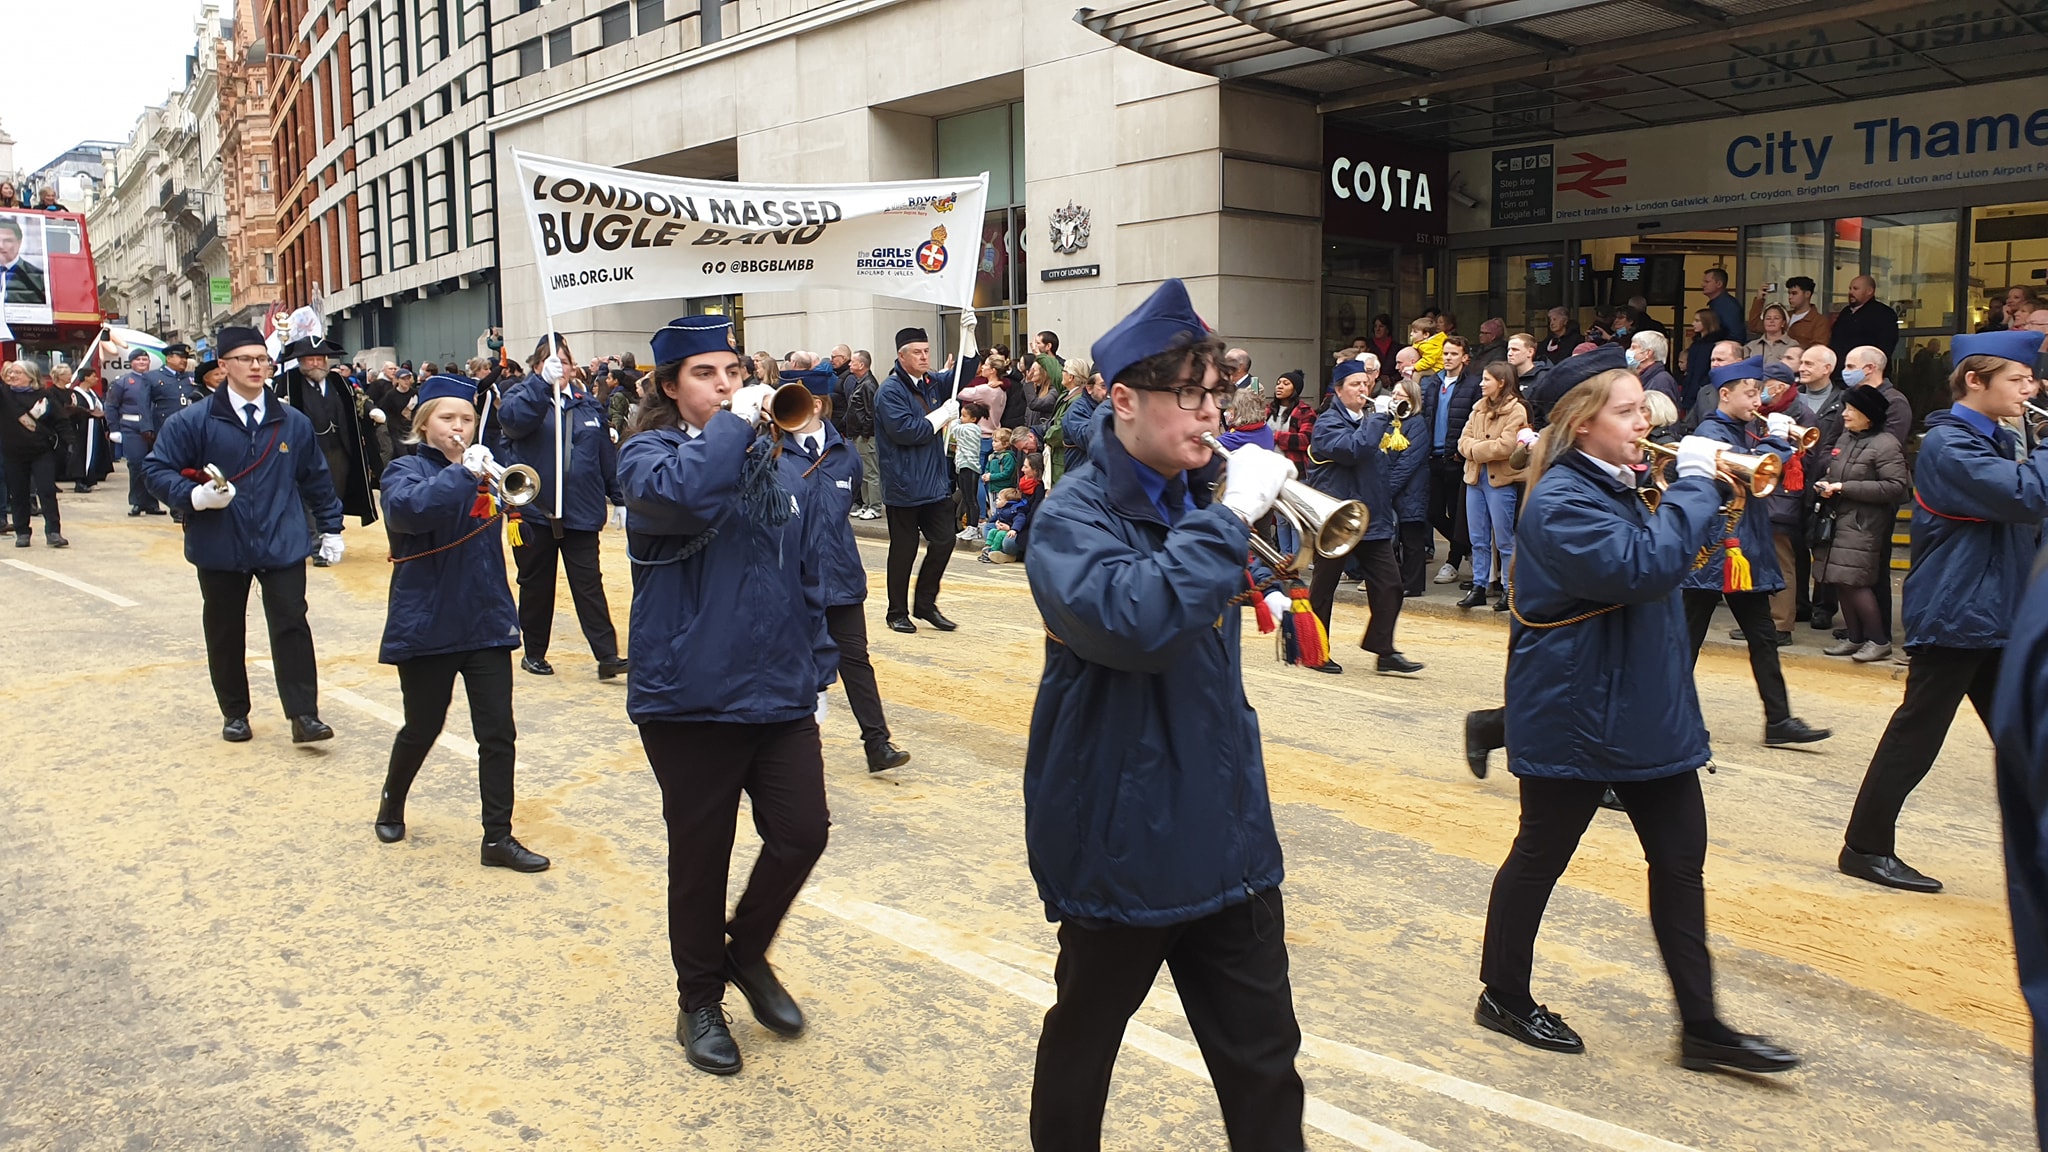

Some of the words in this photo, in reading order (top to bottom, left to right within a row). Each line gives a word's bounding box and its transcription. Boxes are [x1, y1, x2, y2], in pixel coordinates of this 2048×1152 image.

[1727, 130, 1833, 181] City
[1854, 107, 2048, 165] Thame
[1331, 156, 1432, 212] COSTA
[1500, 179, 1518, 188] Step
[1556, 209, 1581, 219] Direct
[1584, 206, 1608, 216] trains
[1611, 205, 1621, 213] to
[1635, 199, 1669, 211] London
[1671, 195, 1709, 208] Gatwick
[1797, 183, 1840, 196] Brighton
[1897, 175, 1928, 186] Luton
[1931, 172, 1953, 182] and
[1956, 168, 1989, 180] Luton
[1992, 163, 2033, 176] Airport
[533, 175, 699, 222] LONDON
[708, 198, 842, 226] MASSED
[1500, 188, 1534, 199] entrance
[1498, 209, 1531, 221] Ludgate
[1533, 207, 1546, 217] Hill
[538, 211, 687, 256] BUGLE
[691, 224, 827, 246] BAND
[858, 250, 870, 258] the
[872, 247, 914, 259] GIRLS'
[730, 258, 814, 274] @BBGBLMBB
[857, 258, 914, 268] BRIGADE
[549, 266, 634, 290] LMBB.ORG.UK
[1048, 270, 1060, 278] CITY
[1060, 269, 1067, 277] OF
[1067, 267, 1090, 276] LONDON
